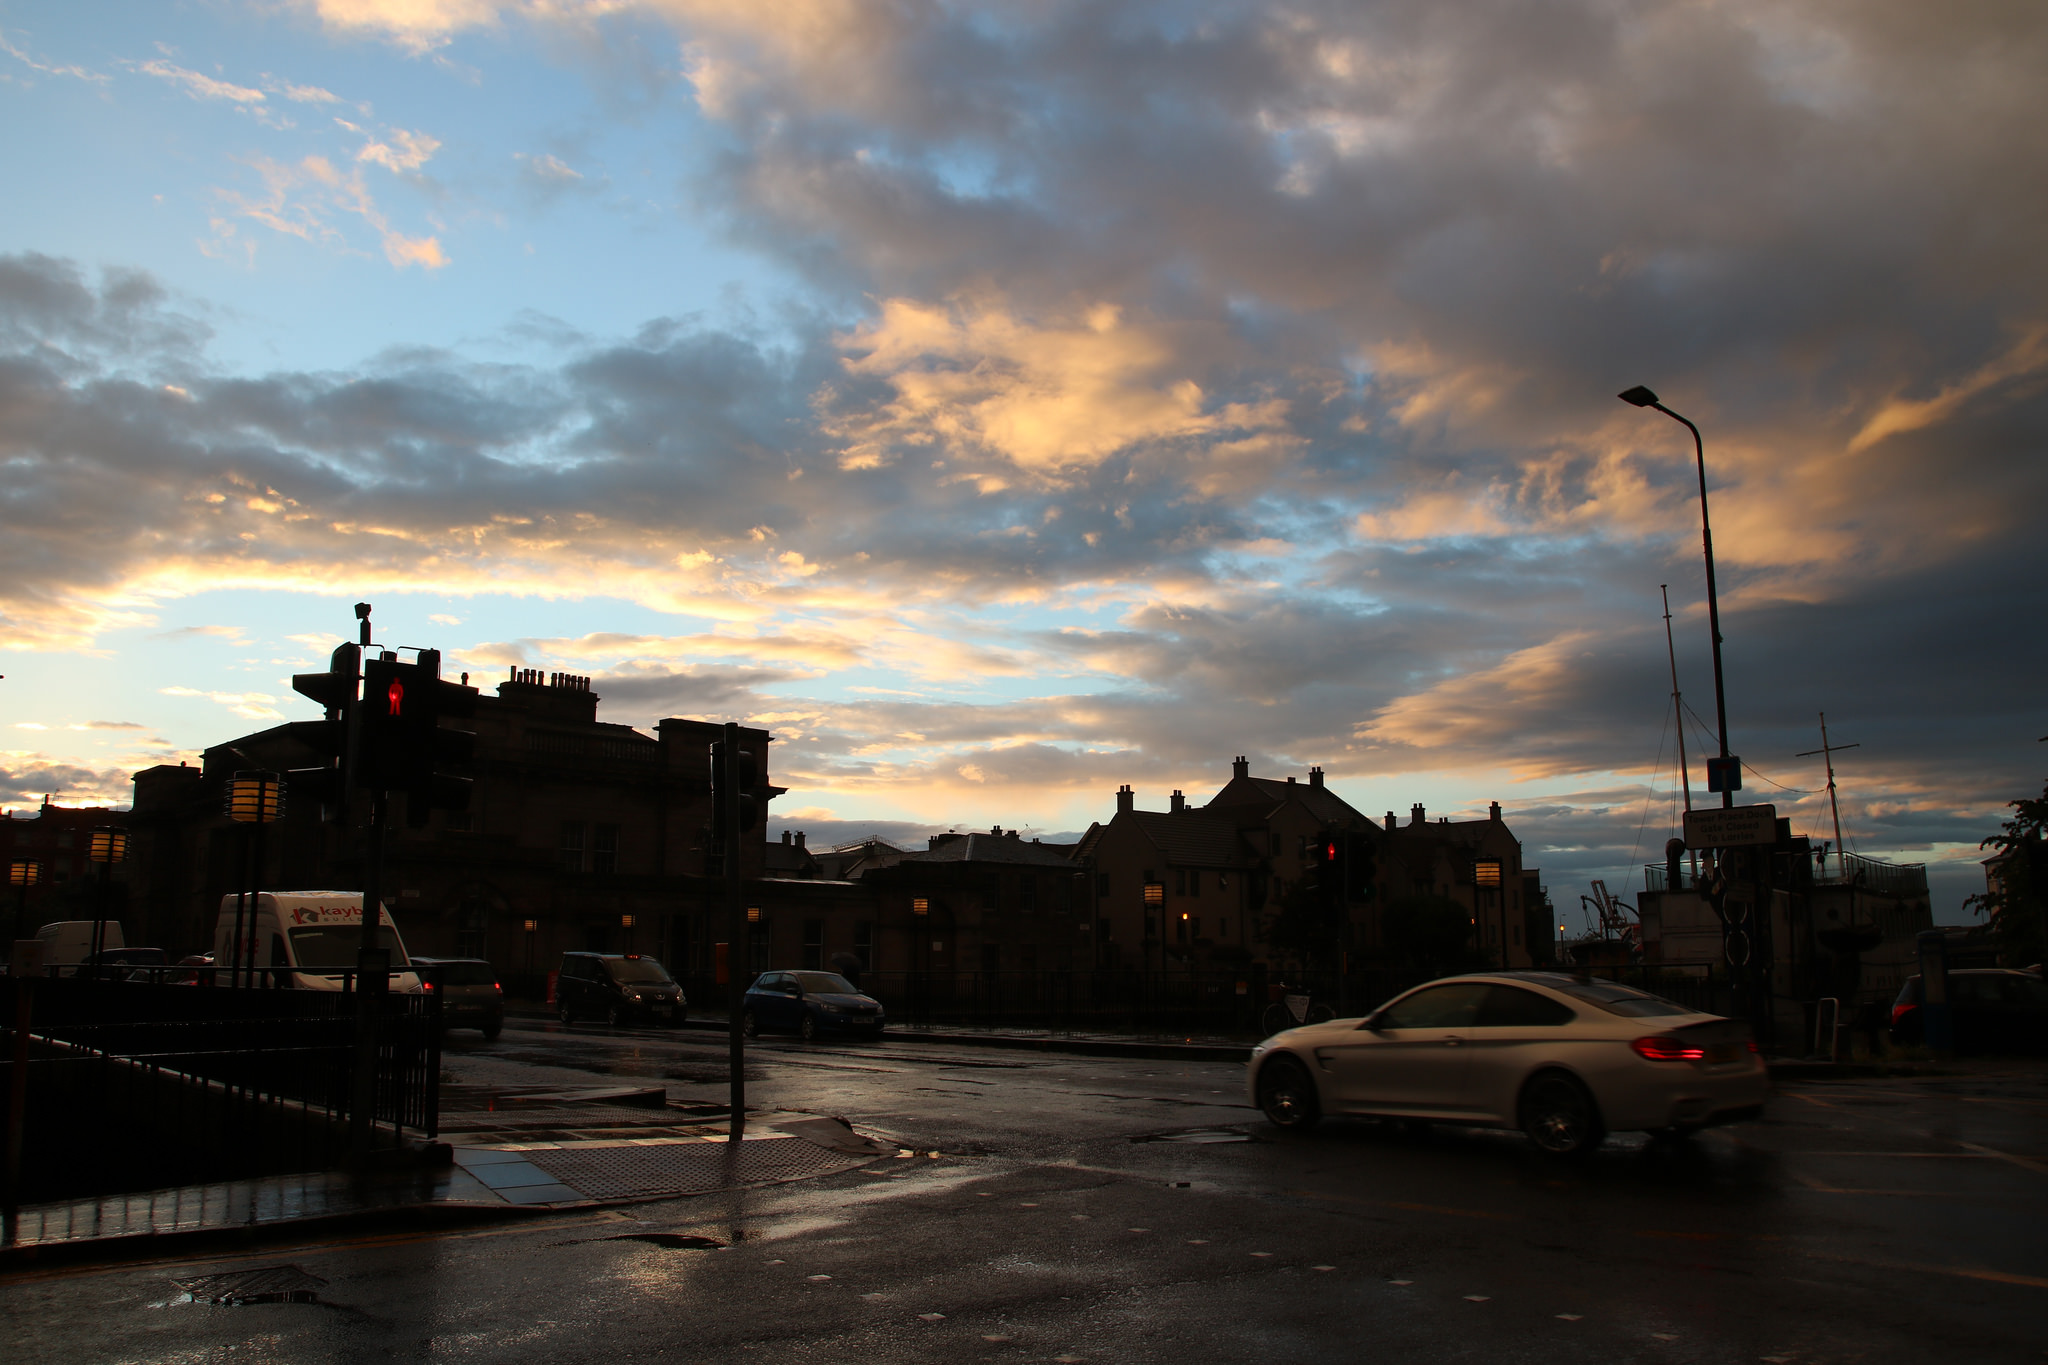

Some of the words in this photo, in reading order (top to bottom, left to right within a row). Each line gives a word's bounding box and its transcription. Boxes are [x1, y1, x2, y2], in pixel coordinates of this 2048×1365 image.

[1718, 812, 1744, 822] Place
[1701, 823, 1722, 832] Gate
[1726, 821, 1759, 831] Closed
[1706, 833, 1718, 842] To
[1721, 831, 1754, 841] Lorries
